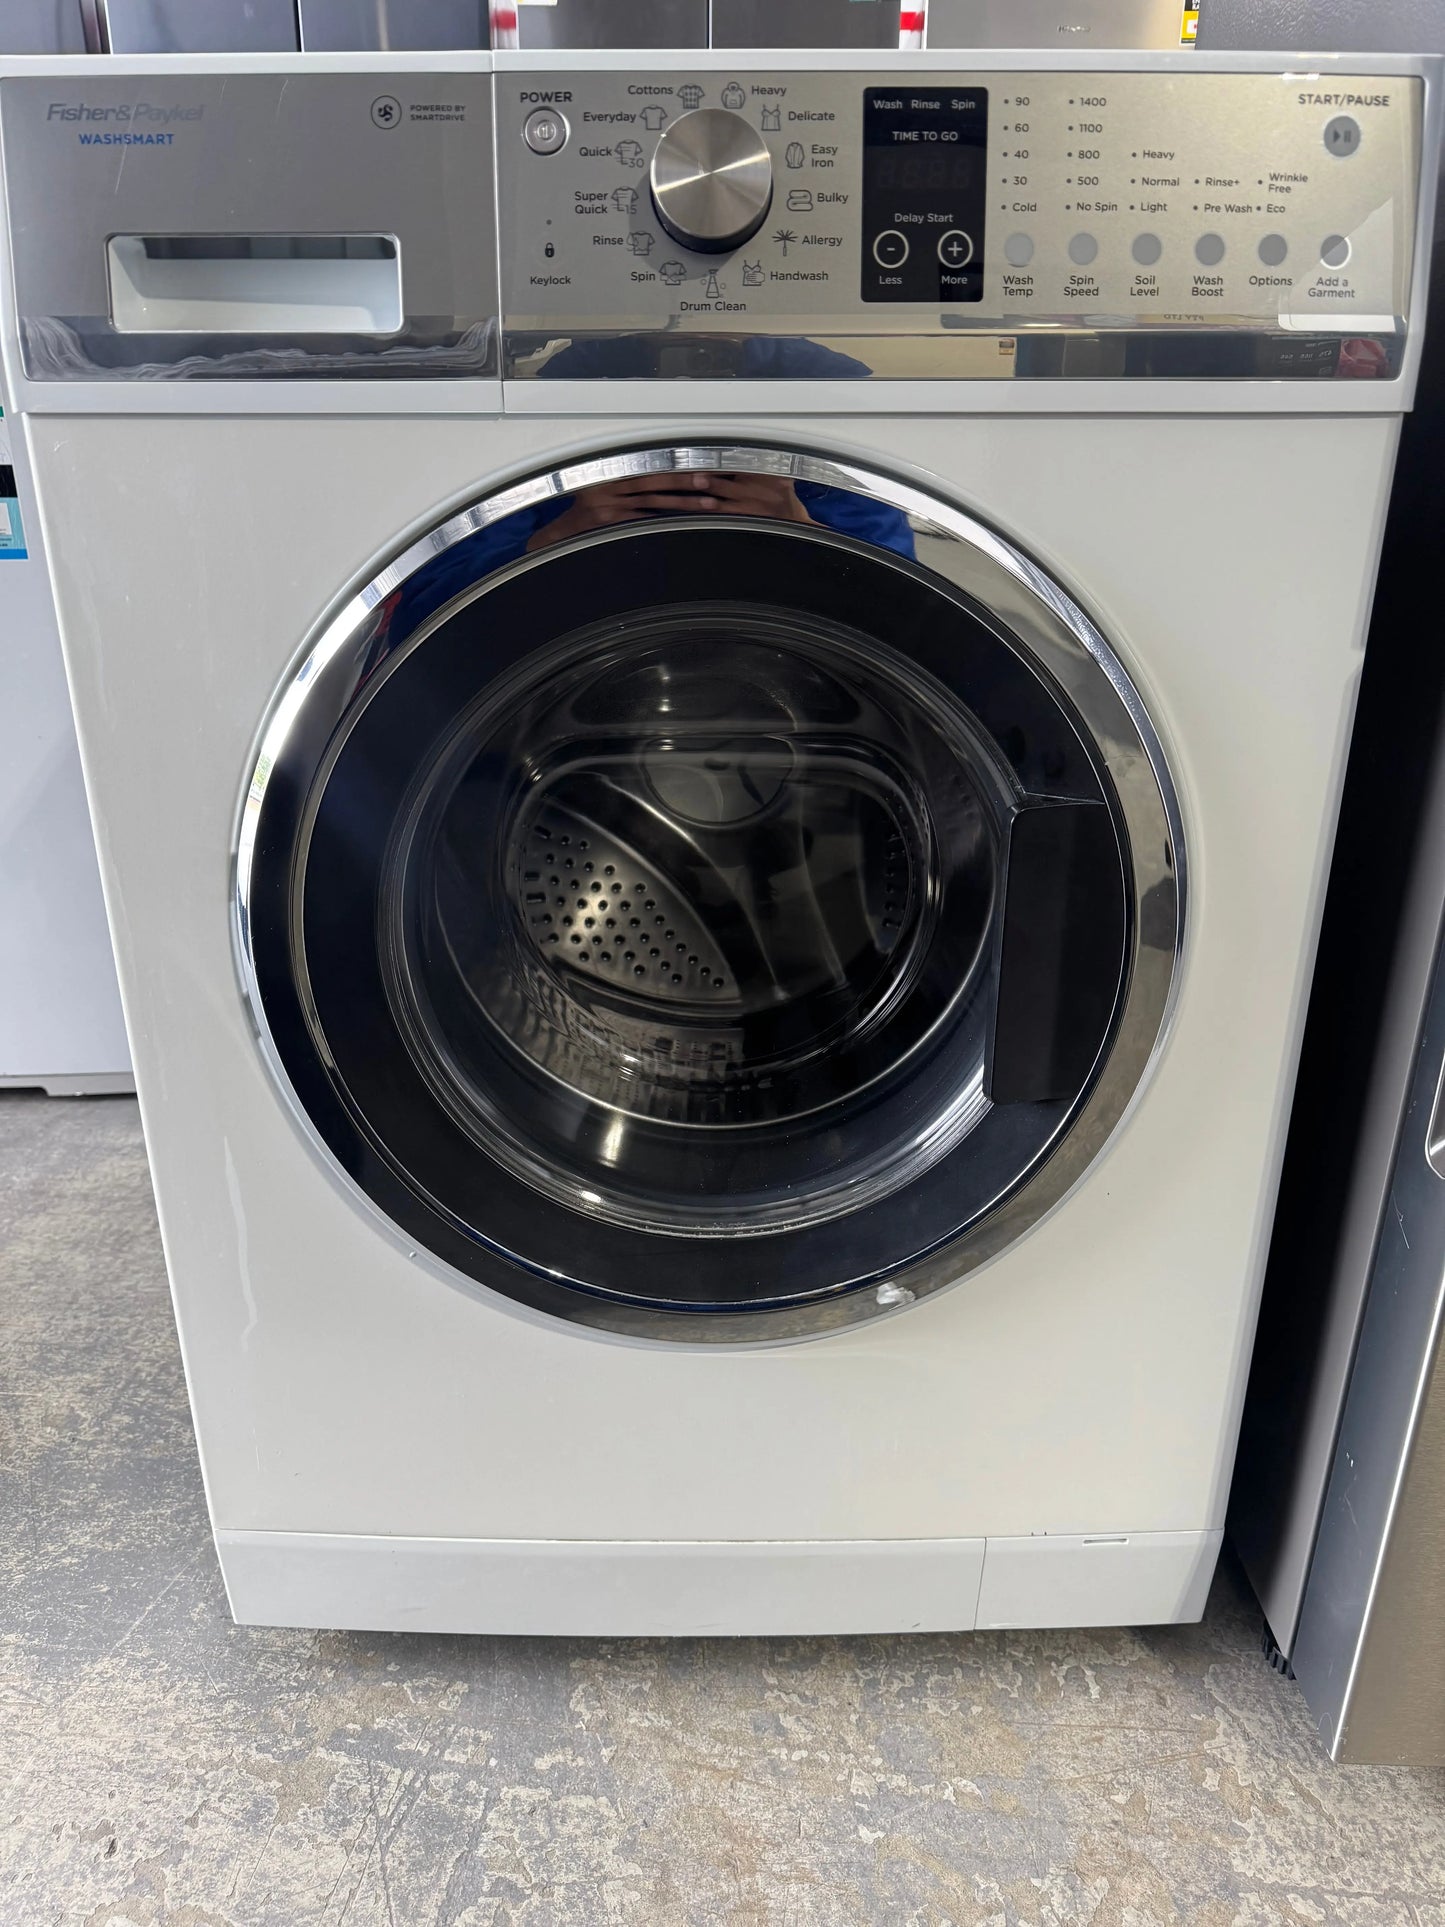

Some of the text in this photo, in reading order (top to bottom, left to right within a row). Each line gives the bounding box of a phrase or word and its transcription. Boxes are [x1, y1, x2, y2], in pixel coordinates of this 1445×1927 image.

[628, 85, 673, 95] Cottons
[752, 86, 786, 96] Heavy
[520, 92, 572, 102] POWER
[1016, 97, 1030, 106] 90
[1080, 97, 1106, 106] 1400
[1299, 94, 1390, 106] START/PAUSE
[873, 100, 975, 110] Wash Rinse Spin
[584, 112, 636, 123] Everyday
[788, 111, 835, 121] Delicate
[1015, 124, 1029, 132] 60
[1080, 124, 1103, 133] 1100
[79, 134, 174, 145] WASHSMART
[893, 131, 958, 140] TIME TO GO
[579, 147, 612, 156] Quick
[812, 144, 838, 156] Easy
[1014, 150, 1029, 159] 40
[1078, 150, 1100, 159] 800
[1143, 150, 1174, 160] Heavy
[812, 158, 833, 167] Iron
[1013, 177, 1027, 185] 30
[1078, 177, 1098, 185] 500
[1142, 177, 1179, 186] Normal
[1206, 177, 1240, 187] Rinse+
[1269, 173, 1308, 183] Wrinkle
[1269, 184, 1291, 193] Free
[575, 191, 608, 203] Super
[817, 193, 848, 204] Bulky
[575, 204, 607, 214] Quick
[1013, 203, 1036, 212] Cold
[1077, 202, 1117, 212] No Spin
[1141, 203, 1167, 213] Light
[1204, 203, 1252, 213] Pre Wash
[1267, 204, 1285, 213] Eco
[895, 213, 953, 224] Delay Start
[593, 236, 623, 245] Rinse
[802, 235, 842, 246] Allergy
[631, 271, 655, 282] Spin
[771, 271, 828, 280] Handwash
[880, 276, 902, 284] Less
[942, 276, 968, 284] More
[1003, 276, 1033, 285] Wash
[1135, 275, 1155, 285] Soil
[1193, 276, 1223, 285] Wash
[530, 276, 571, 286] Keylock
[1070, 275, 1094, 287] Spin
[1249, 276, 1292, 287] Options
[1316, 277, 1348, 287] Add a
[1003, 287, 1033, 297] Temp
[1064, 286, 1099, 297] Speed
[1130, 287, 1159, 296] Level
[1192, 286, 1223, 296] Boost
[1308, 288, 1355, 298] Garment
[681, 301, 746, 311] Drum Clean
